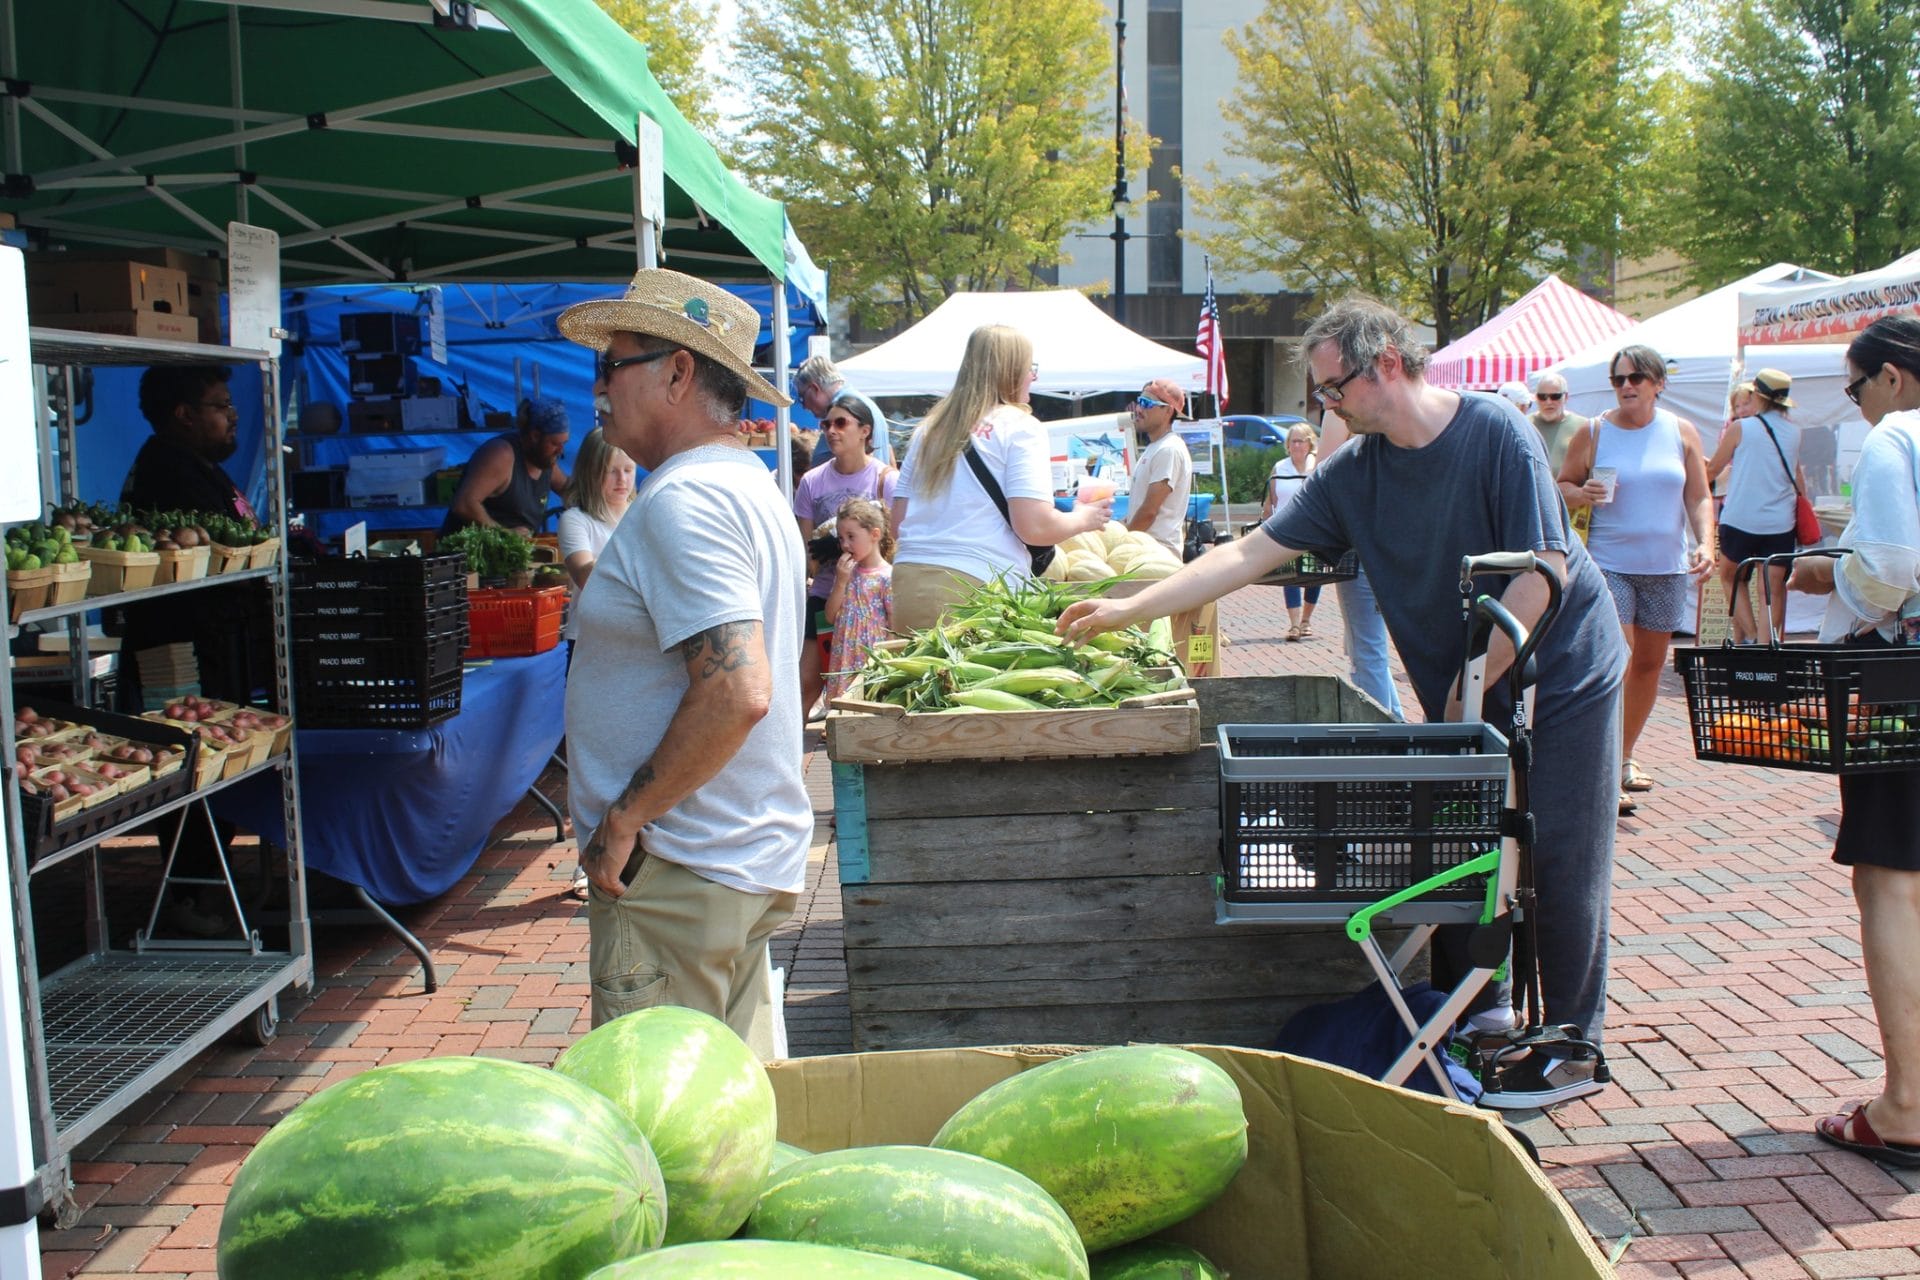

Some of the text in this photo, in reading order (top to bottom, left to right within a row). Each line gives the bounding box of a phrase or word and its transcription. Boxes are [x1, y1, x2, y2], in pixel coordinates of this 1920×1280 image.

[1829, 296, 1845, 315] IN
[316, 581, 336, 589] PRADO
[318, 607, 338, 615] PRADO
[341, 657, 365, 665] MARKET
[1735, 671, 1778, 682] PRADO MARKET
[1513, 701, 1525, 726] hugo
